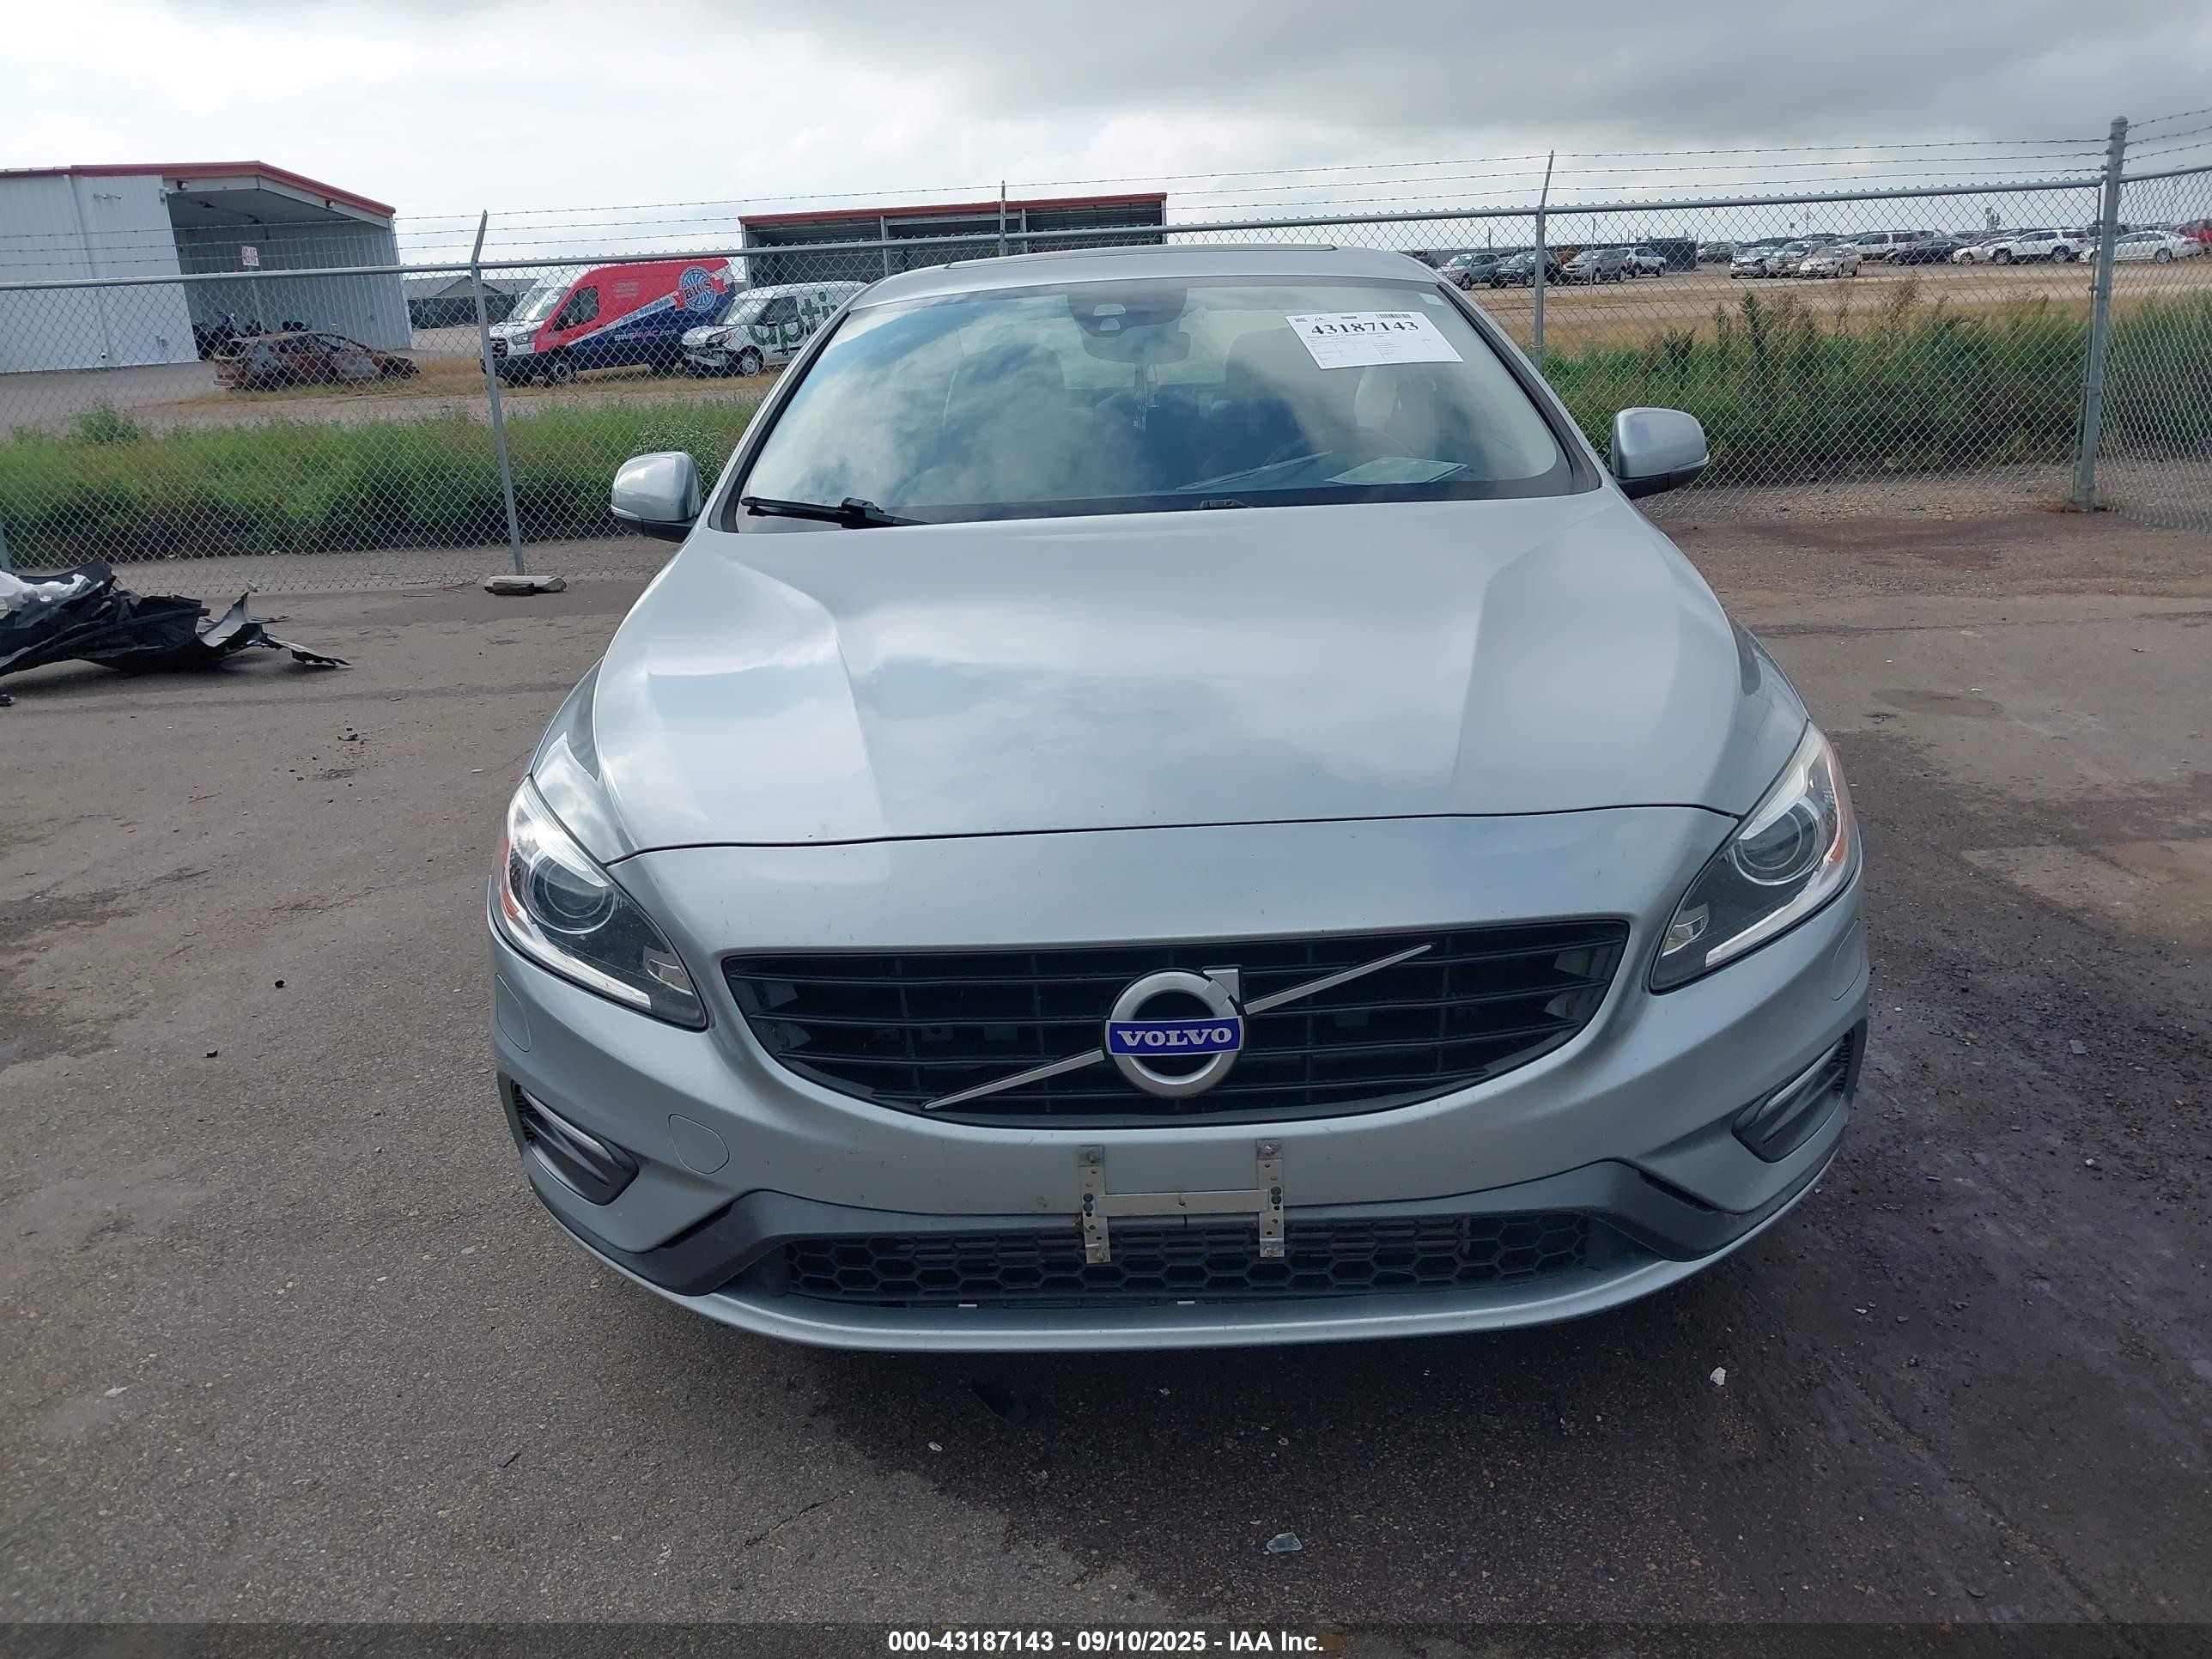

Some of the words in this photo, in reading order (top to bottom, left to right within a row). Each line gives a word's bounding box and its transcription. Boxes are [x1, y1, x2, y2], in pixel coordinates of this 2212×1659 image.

[684, 280, 712, 299] BWS
[1311, 321, 1419, 335] 43187143
[1117, 1027, 1232, 1047] VOLVO
